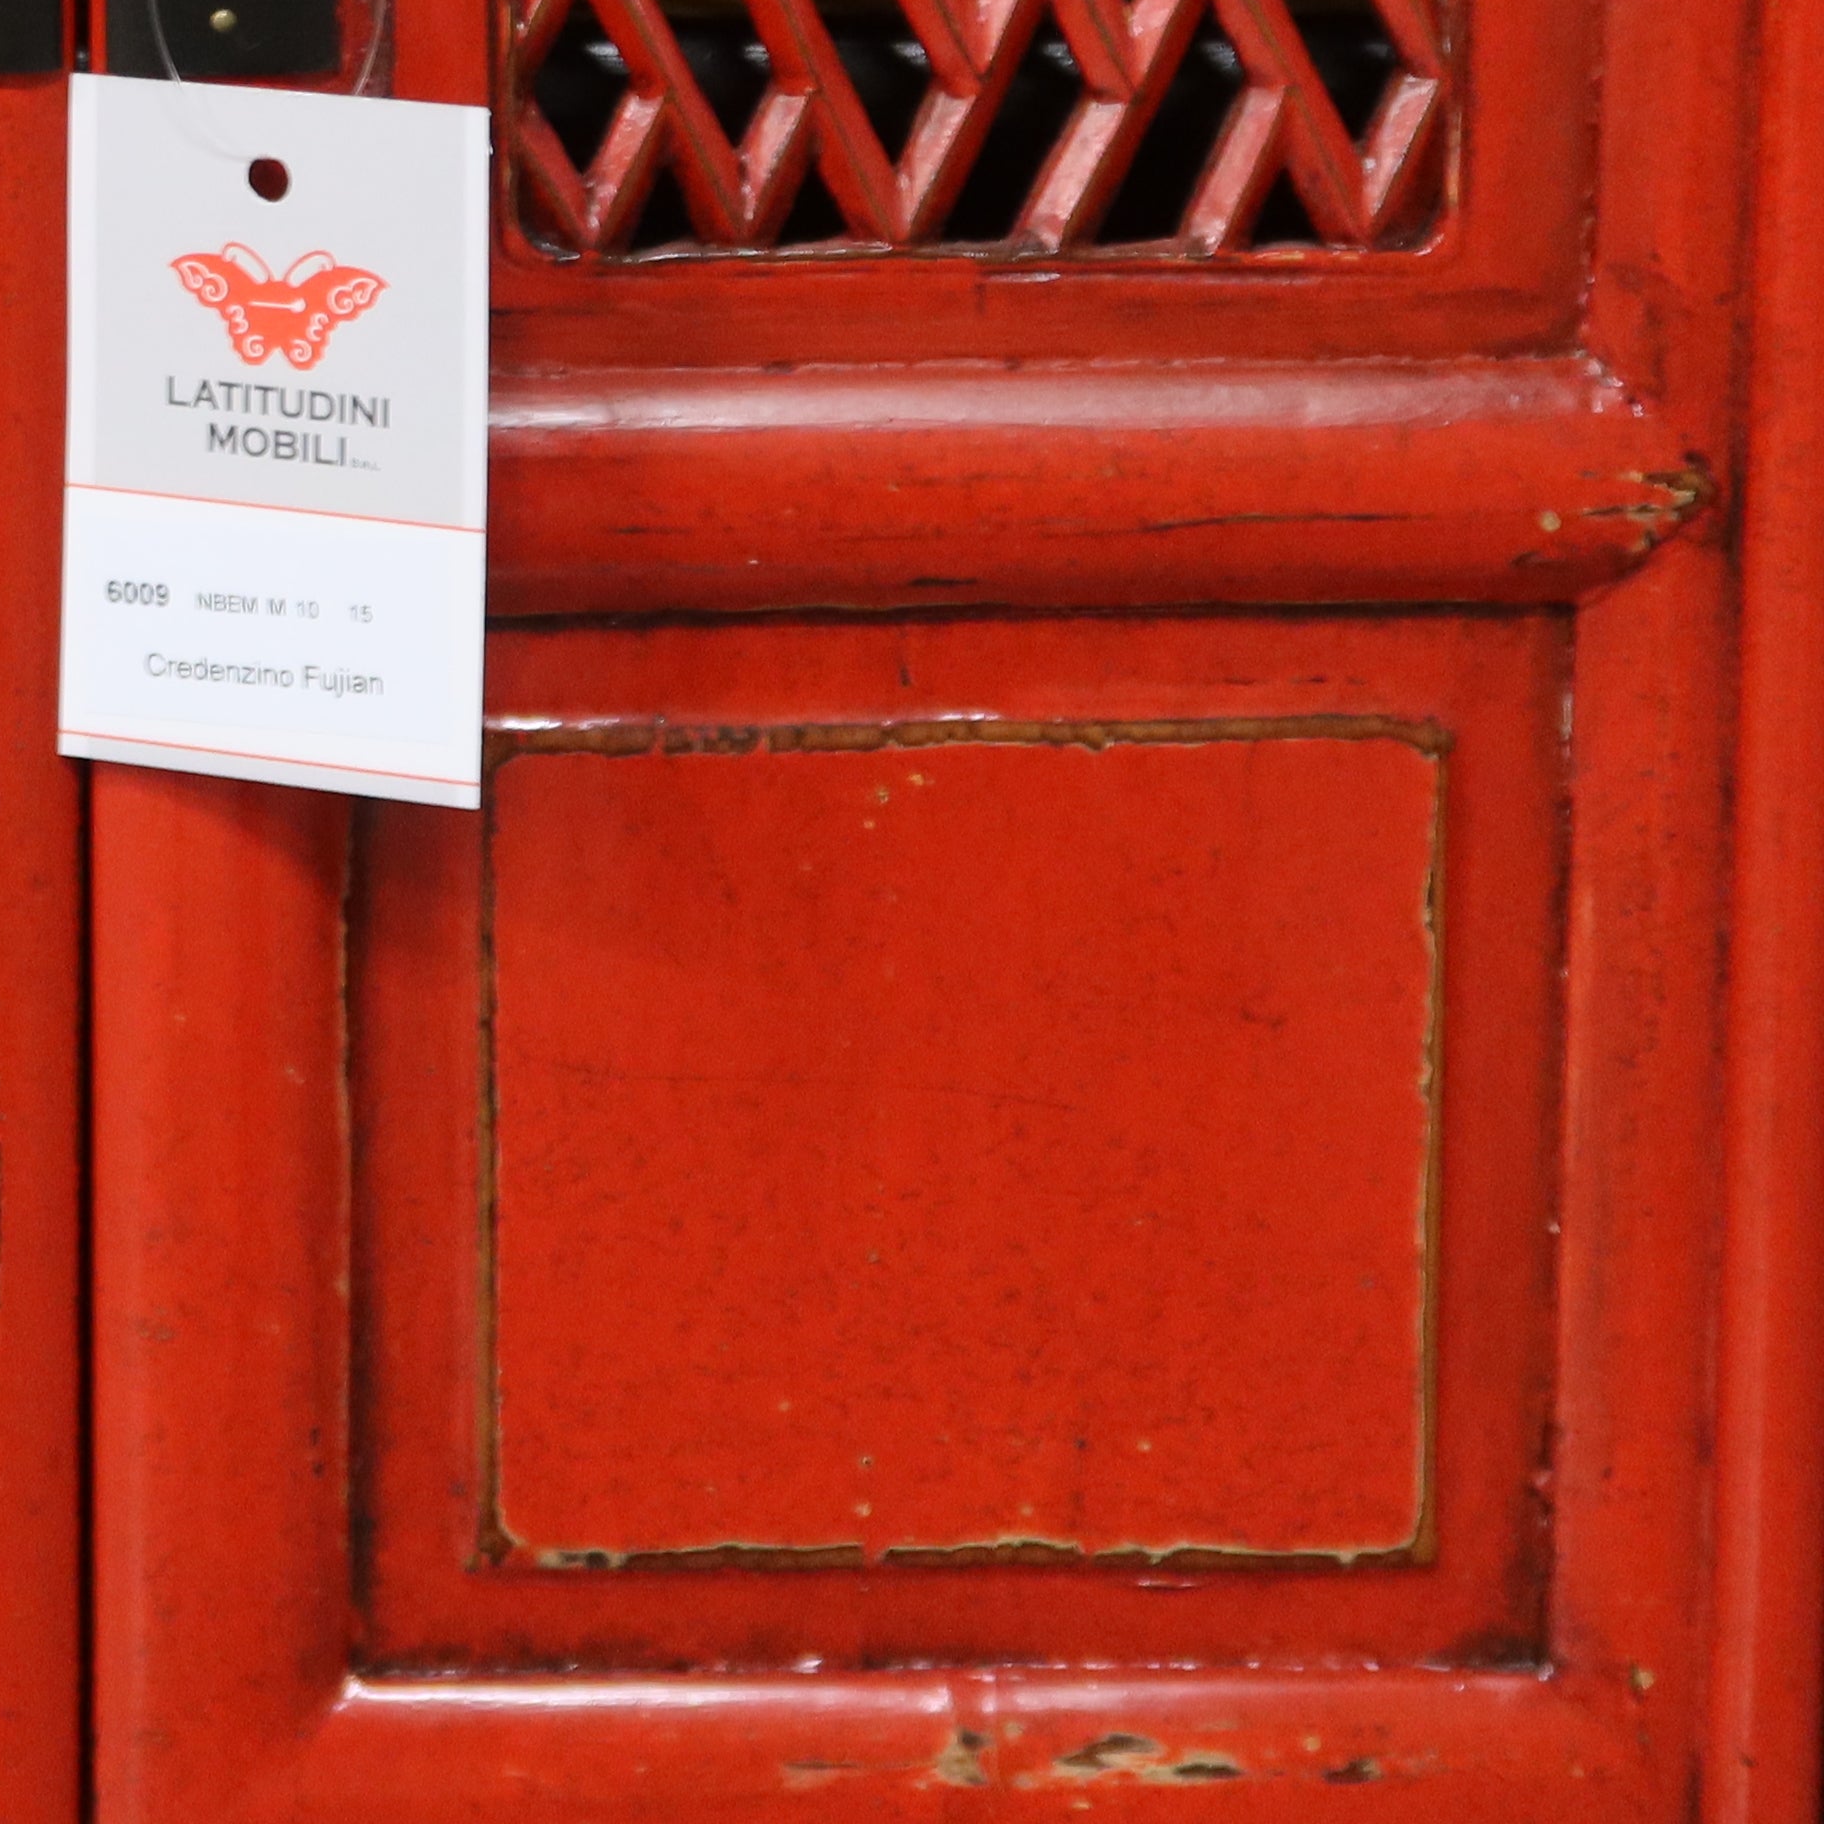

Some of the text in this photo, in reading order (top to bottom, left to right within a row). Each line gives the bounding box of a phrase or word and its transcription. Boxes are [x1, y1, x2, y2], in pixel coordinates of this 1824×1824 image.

[166, 376, 391, 428] LATITUDINI
[208, 423, 347, 467] MOBILI
[105, 580, 170, 606] 6009
[197, 593, 258, 614] NBEM
[297, 601, 320, 619] 10
[350, 605, 374, 623] 15
[145, 652, 384, 699] Credenzino Fujian
